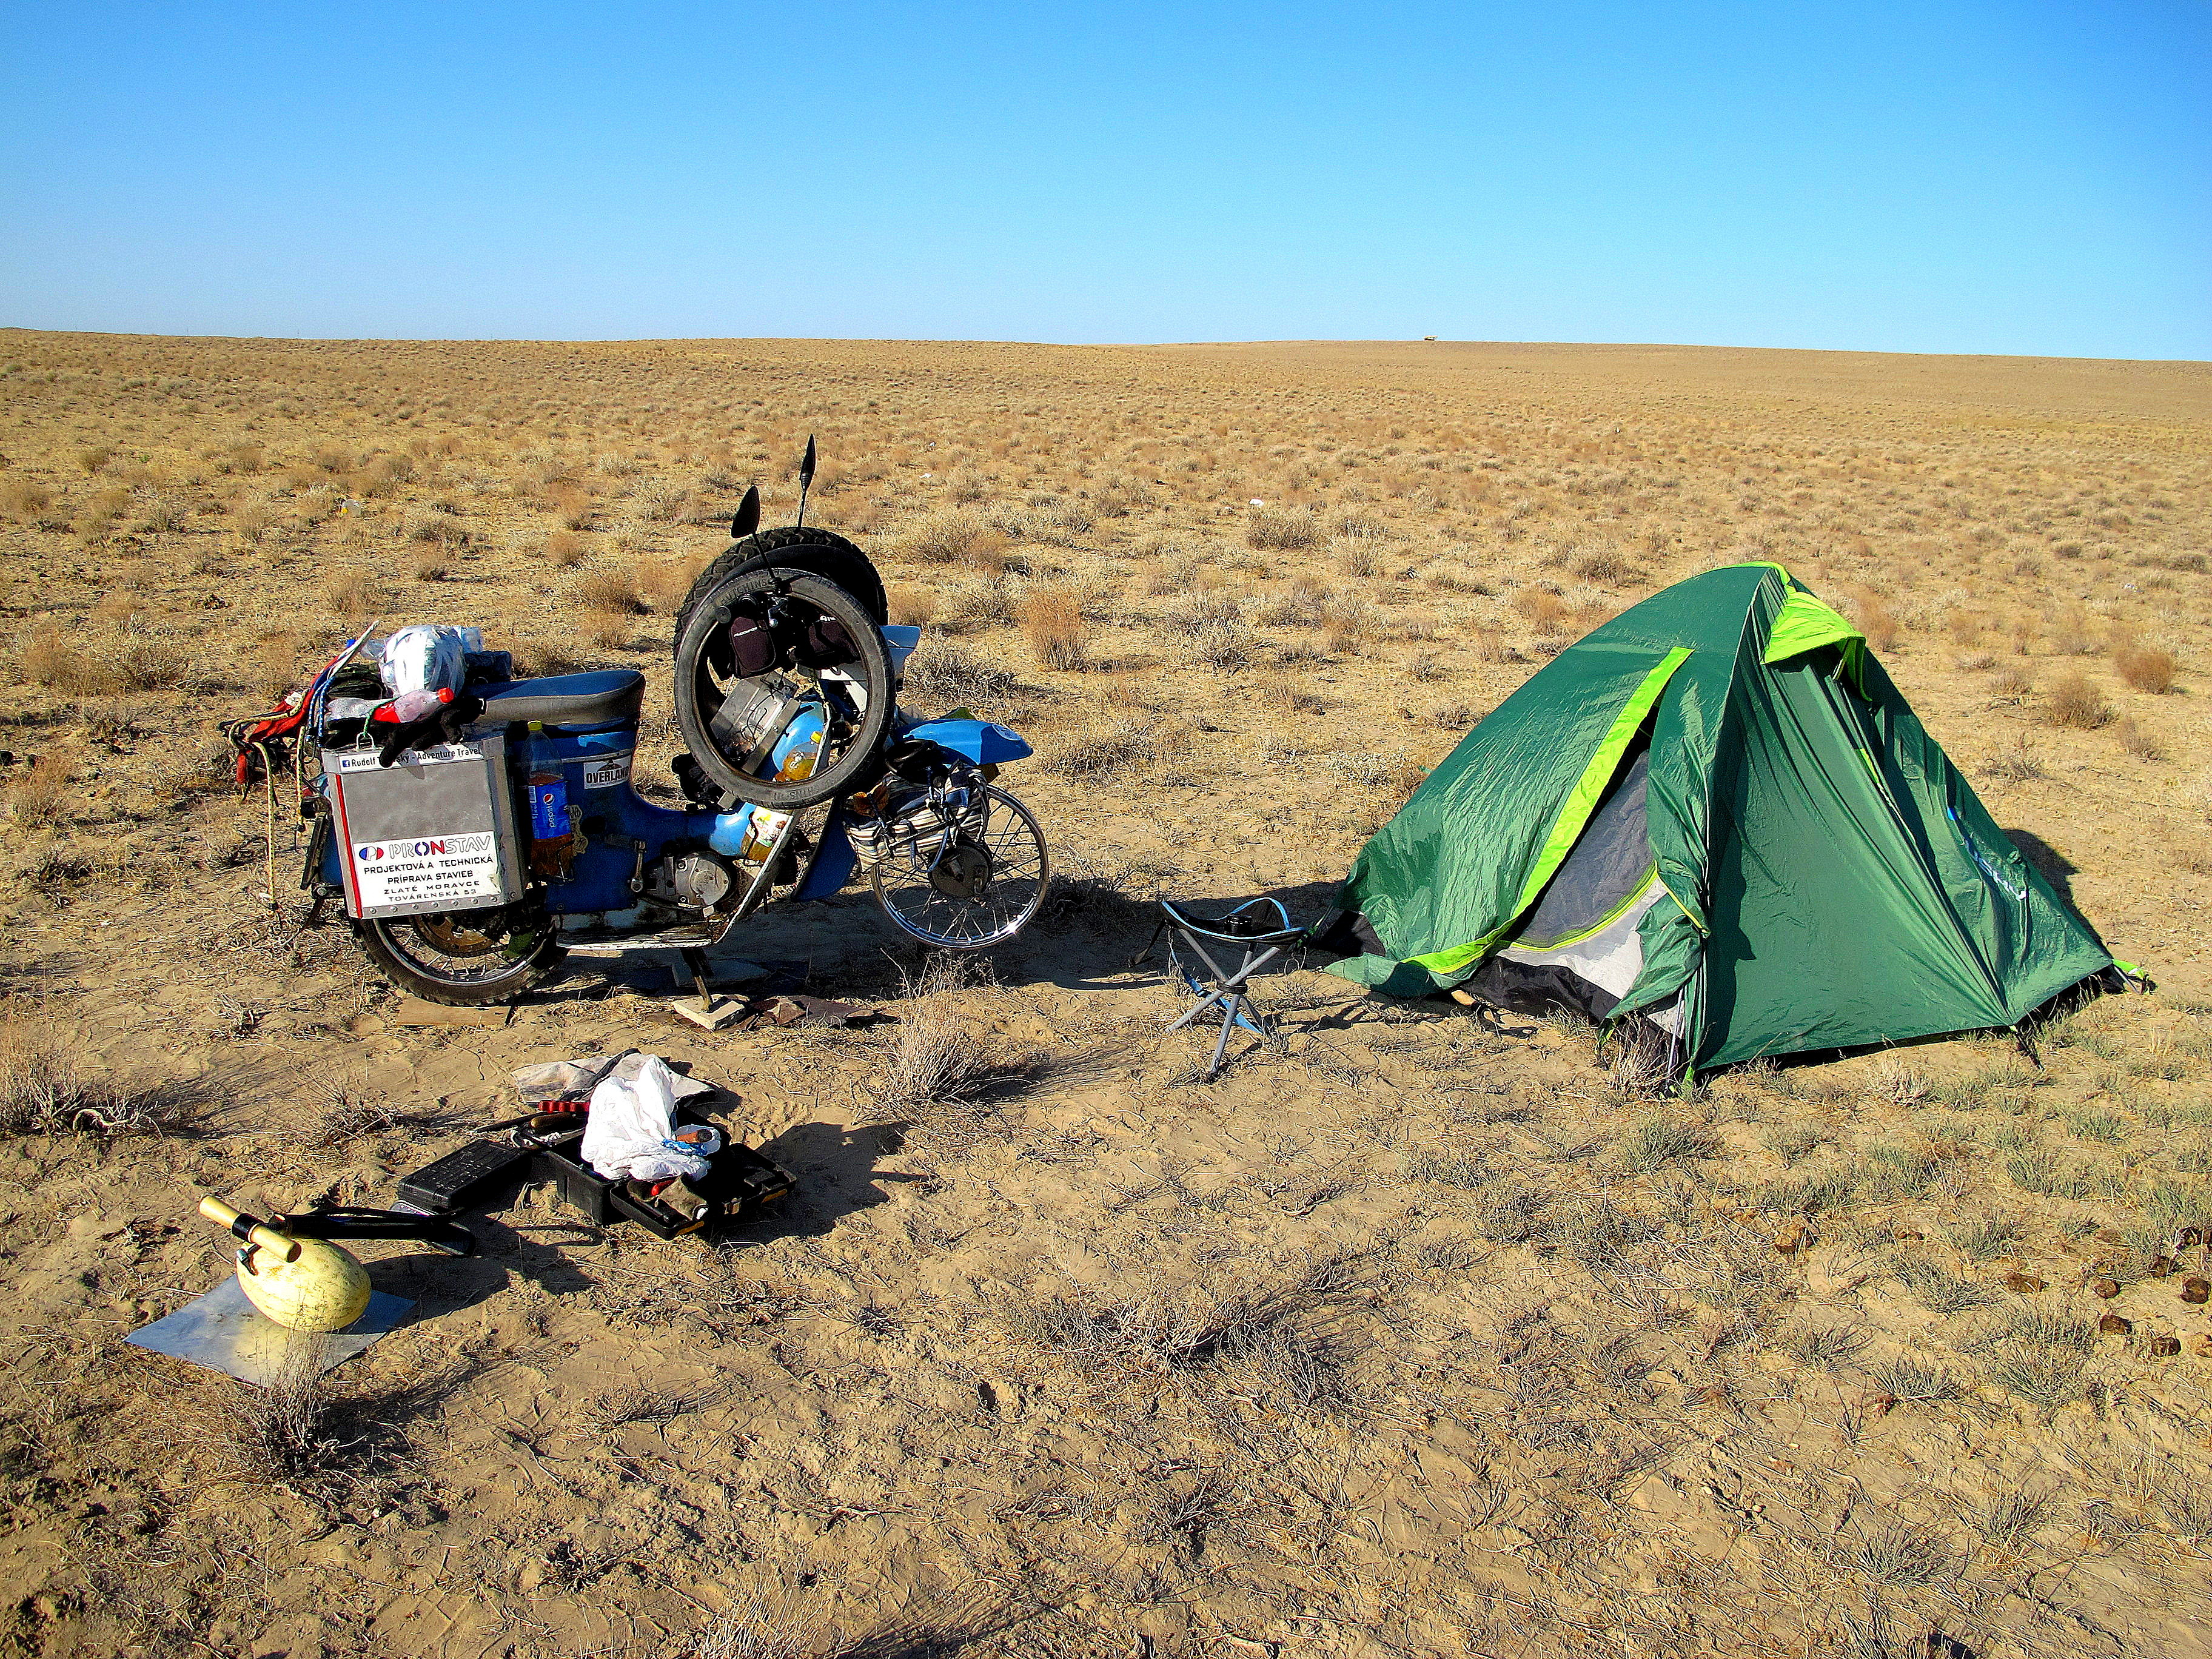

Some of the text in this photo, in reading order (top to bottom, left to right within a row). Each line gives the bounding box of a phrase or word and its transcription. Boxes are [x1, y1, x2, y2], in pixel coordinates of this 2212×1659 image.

[352, 757, 375, 766] Rudolf
[418, 751, 455, 760] Adventure
[457, 747, 481, 756] Travel
[586, 765, 629, 784] OVERLAND
[546, 805, 557, 828] pepsi
[389, 835, 491, 859] PRONSTAV
[364, 860, 425, 874] PROJEKTOVÁ
[439, 853, 494, 867] TECHNICKÁ
[384, 880, 480, 894] ZLATÉ MORAVCE
[387, 870, 474, 885] PRÍPRAVA STAVIEB
[388, 889, 459, 902] TOVÁRENSKÁ
